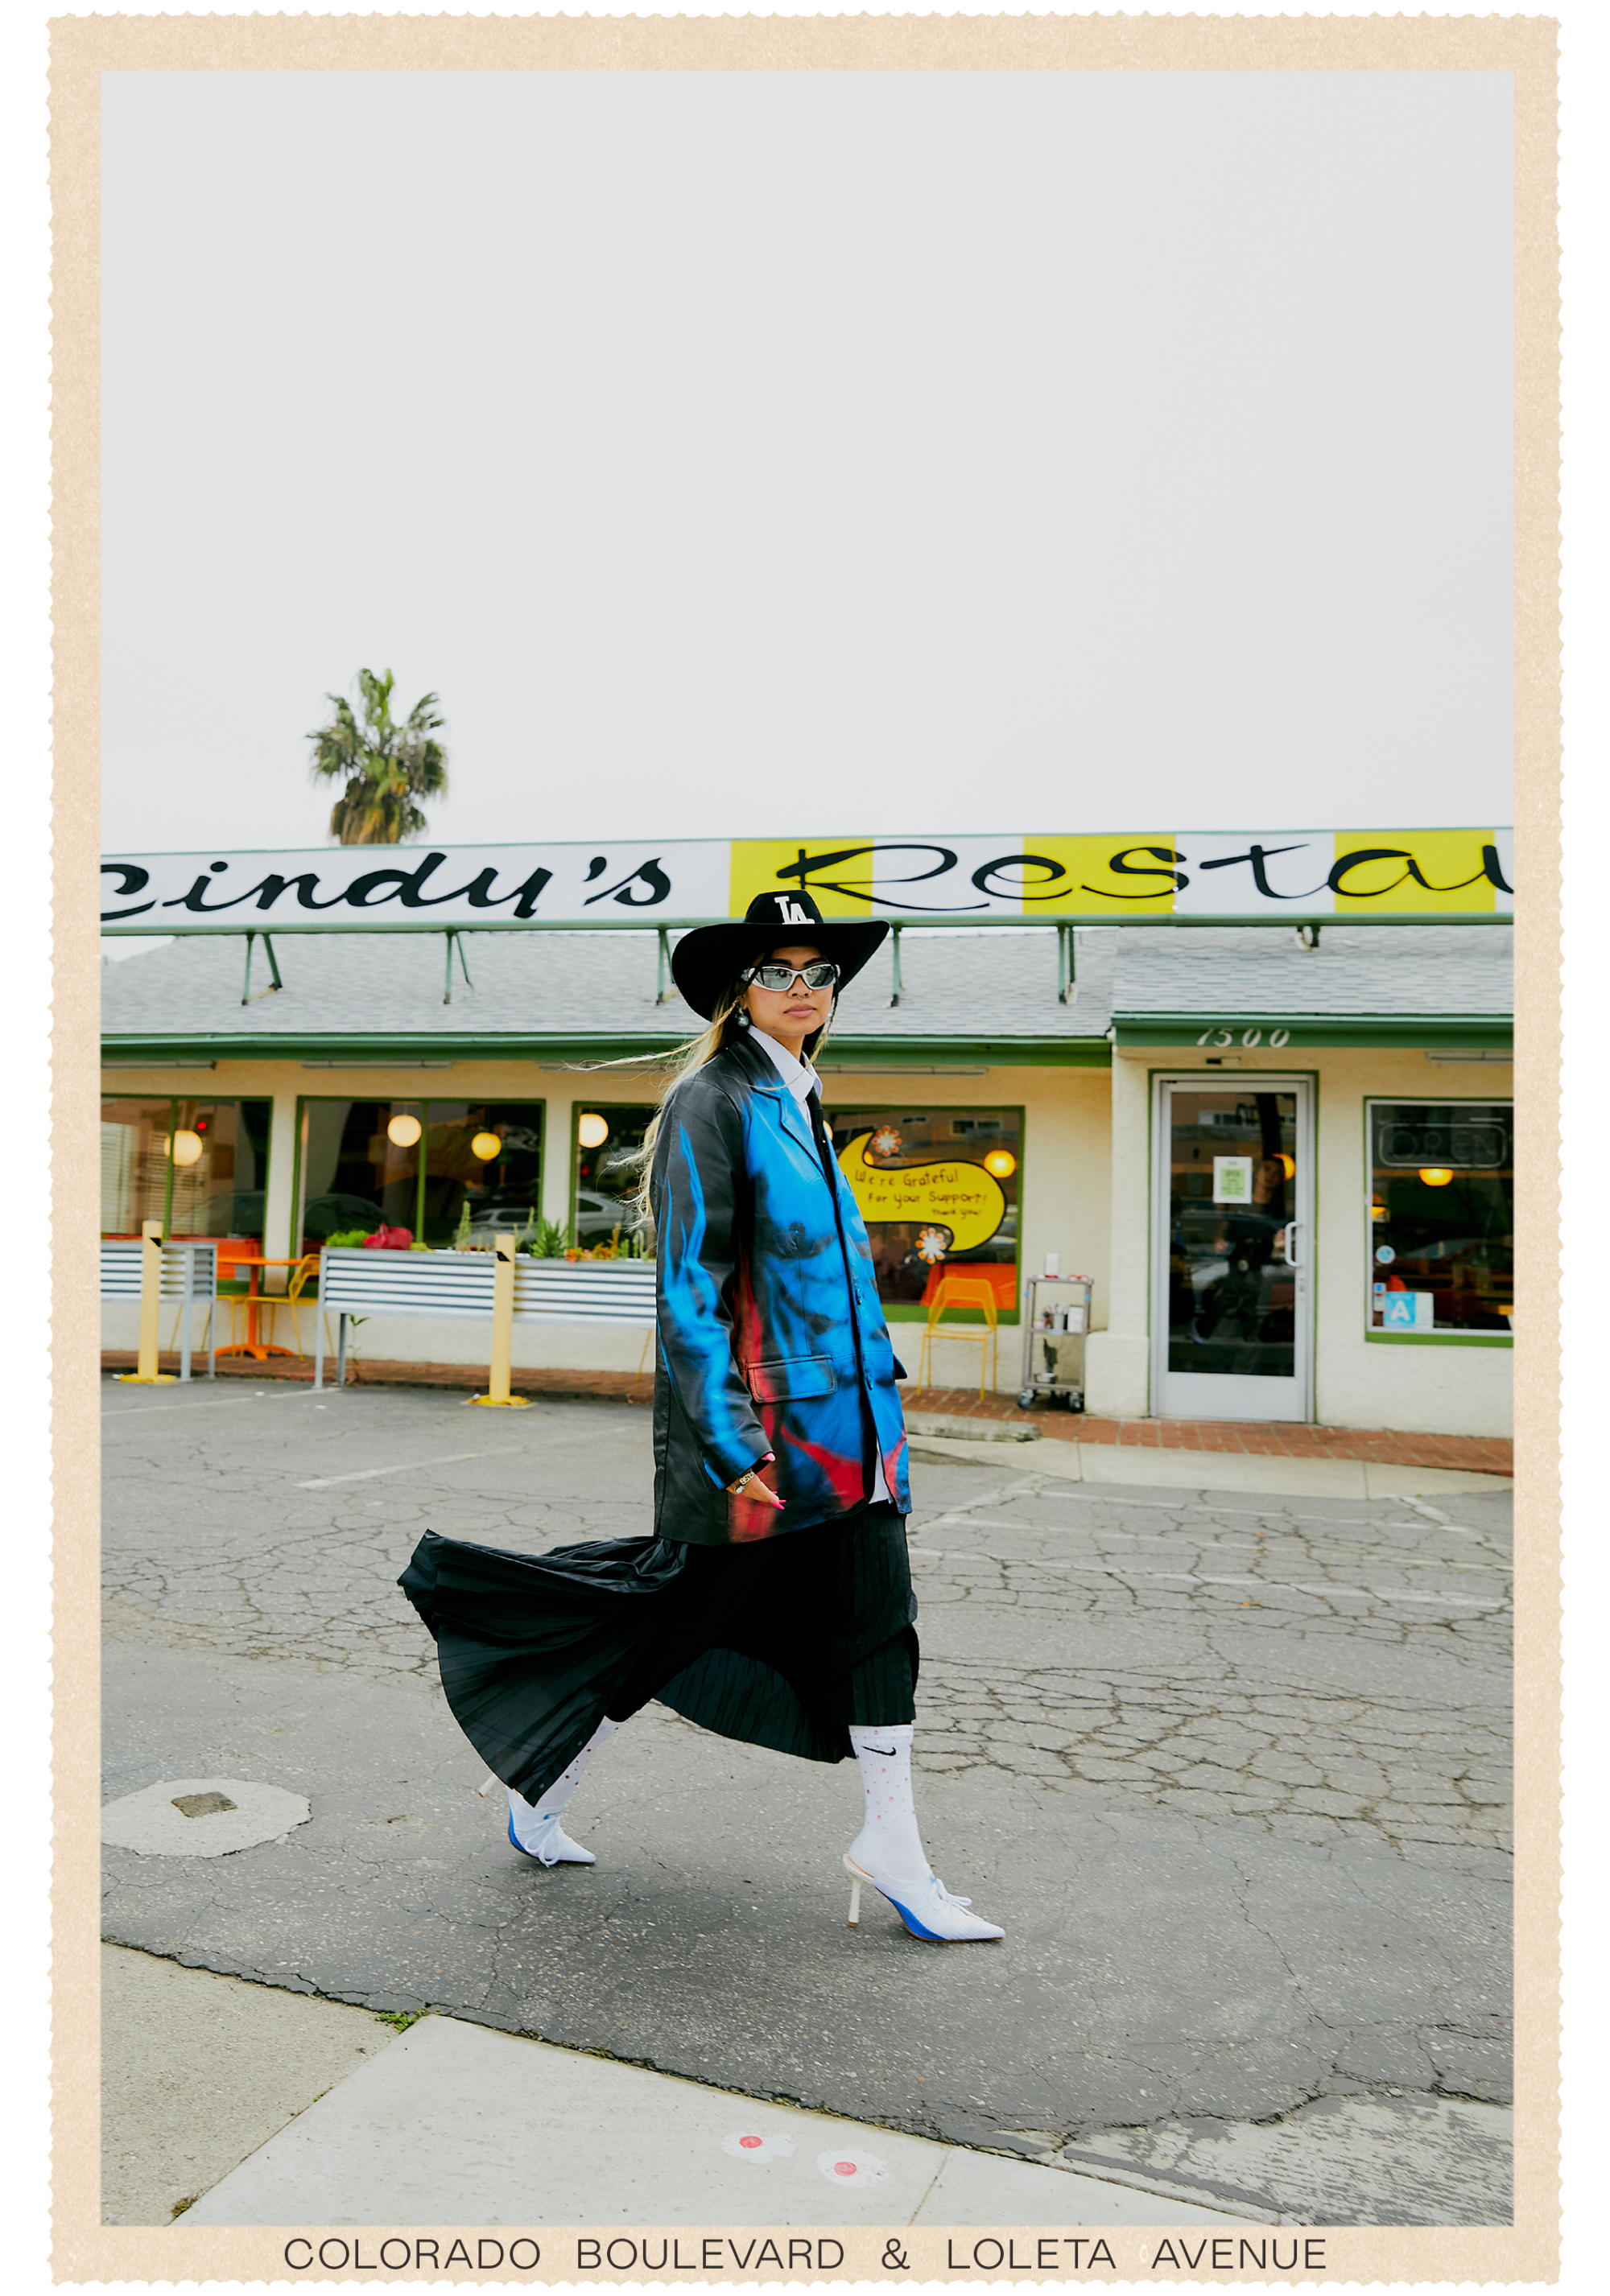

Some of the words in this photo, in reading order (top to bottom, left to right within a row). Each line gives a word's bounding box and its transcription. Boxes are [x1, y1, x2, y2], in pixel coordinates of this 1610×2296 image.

[774, 896, 815, 925] LA
[1196, 1028, 1290, 1049] 1500
[1391, 1130, 1497, 1160] OPEN
[855, 1169, 895, 1186] We're
[903, 1169, 959, 1187] Grateful
[869, 1192, 887, 1202] For
[929, 1190, 987, 1205] Support!
[1390, 1300, 1411, 1321] A
